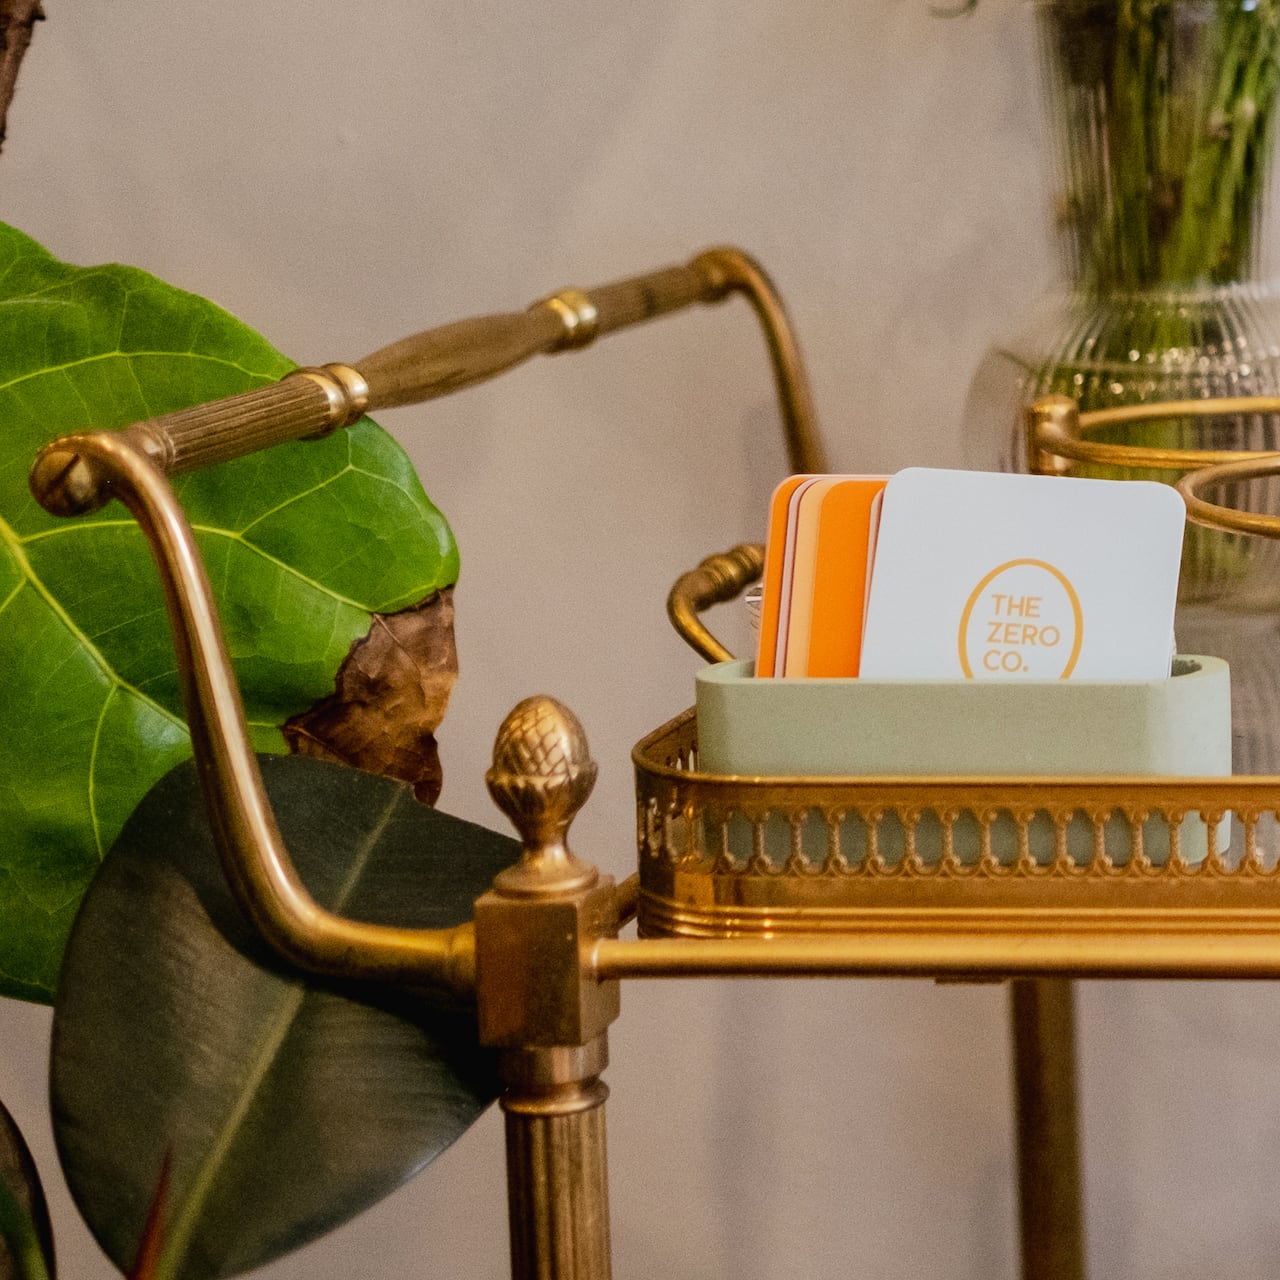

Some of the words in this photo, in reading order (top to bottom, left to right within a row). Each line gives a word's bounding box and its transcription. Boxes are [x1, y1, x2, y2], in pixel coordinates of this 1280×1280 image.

[991, 593, 1043, 618] THE
[986, 621, 1060, 648] ZERO
[983, 649, 1030, 673] CO.
